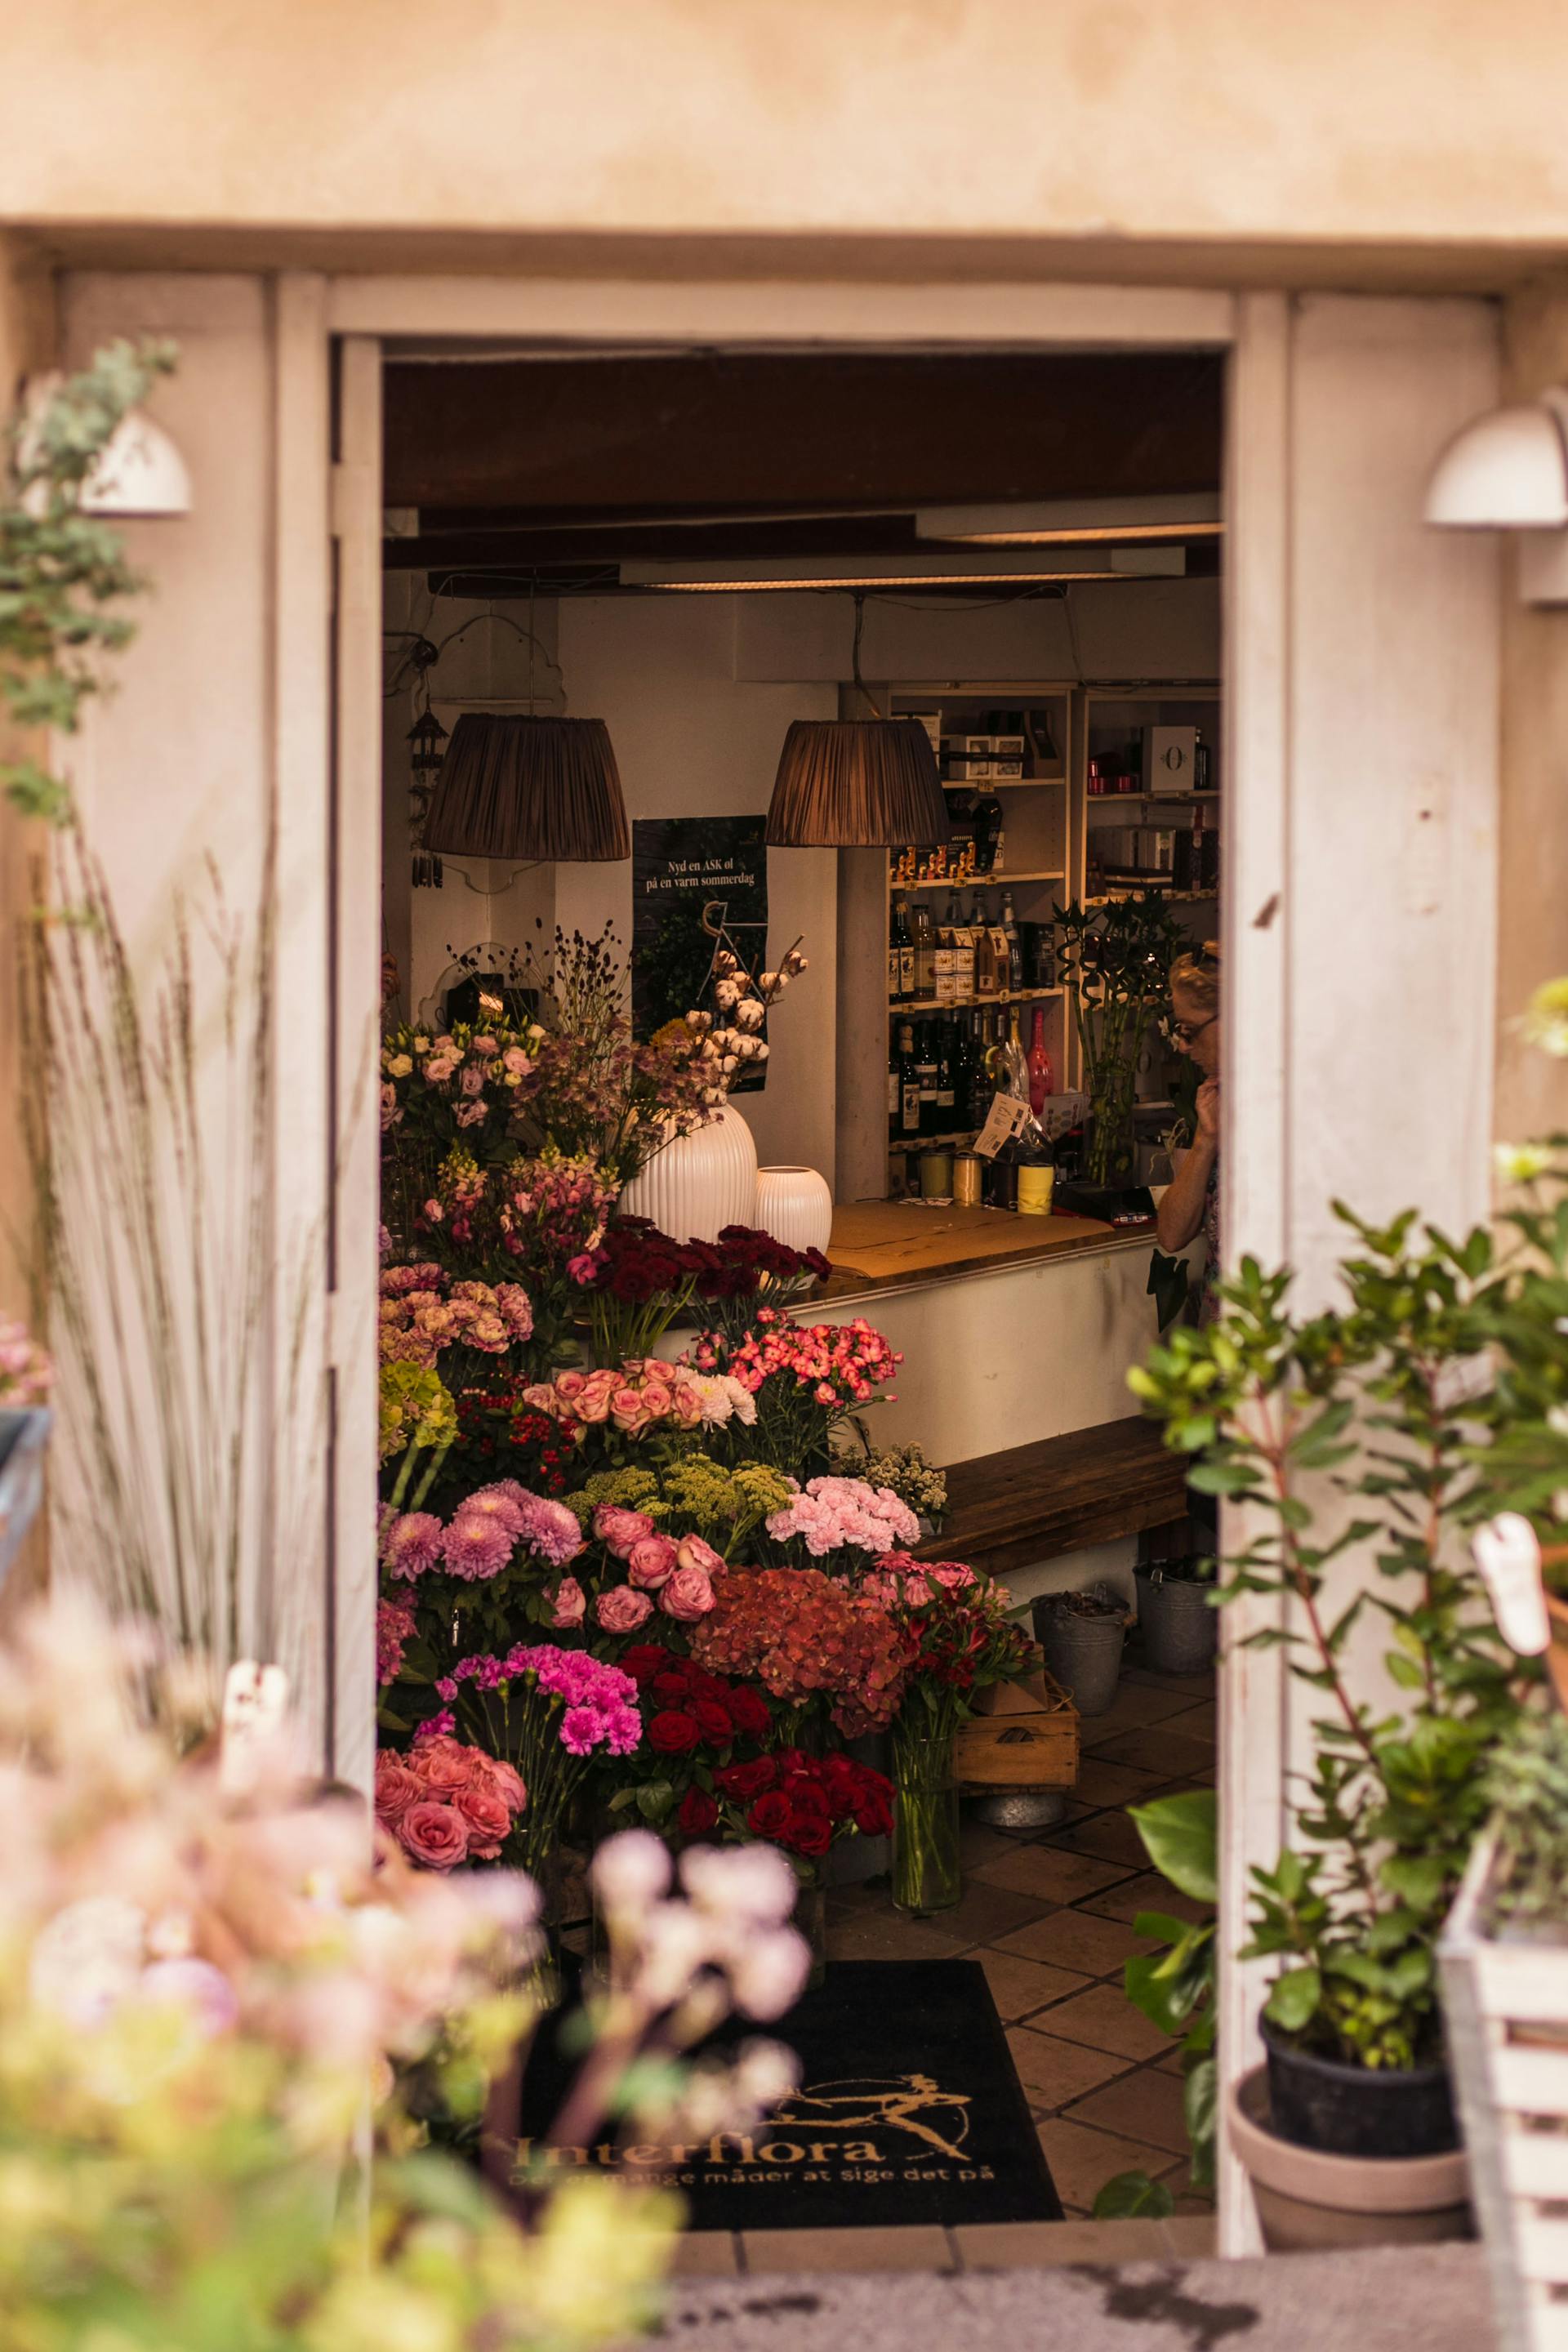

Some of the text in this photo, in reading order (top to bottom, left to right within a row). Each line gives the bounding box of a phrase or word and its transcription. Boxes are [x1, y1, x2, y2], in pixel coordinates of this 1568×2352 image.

[668, 858, 733, 875] Nyd en ASK øl
[646, 871, 755, 893] på en varm sommerdag
[512, 2132, 886, 2167] Interflora
[703, 2168, 793, 2185] måder
[803, 2168, 831, 2182] at
[840, 2166, 894, 2184] sige
[903, 2167, 950, 2181] det
[958, 2164, 995, 2184] på
